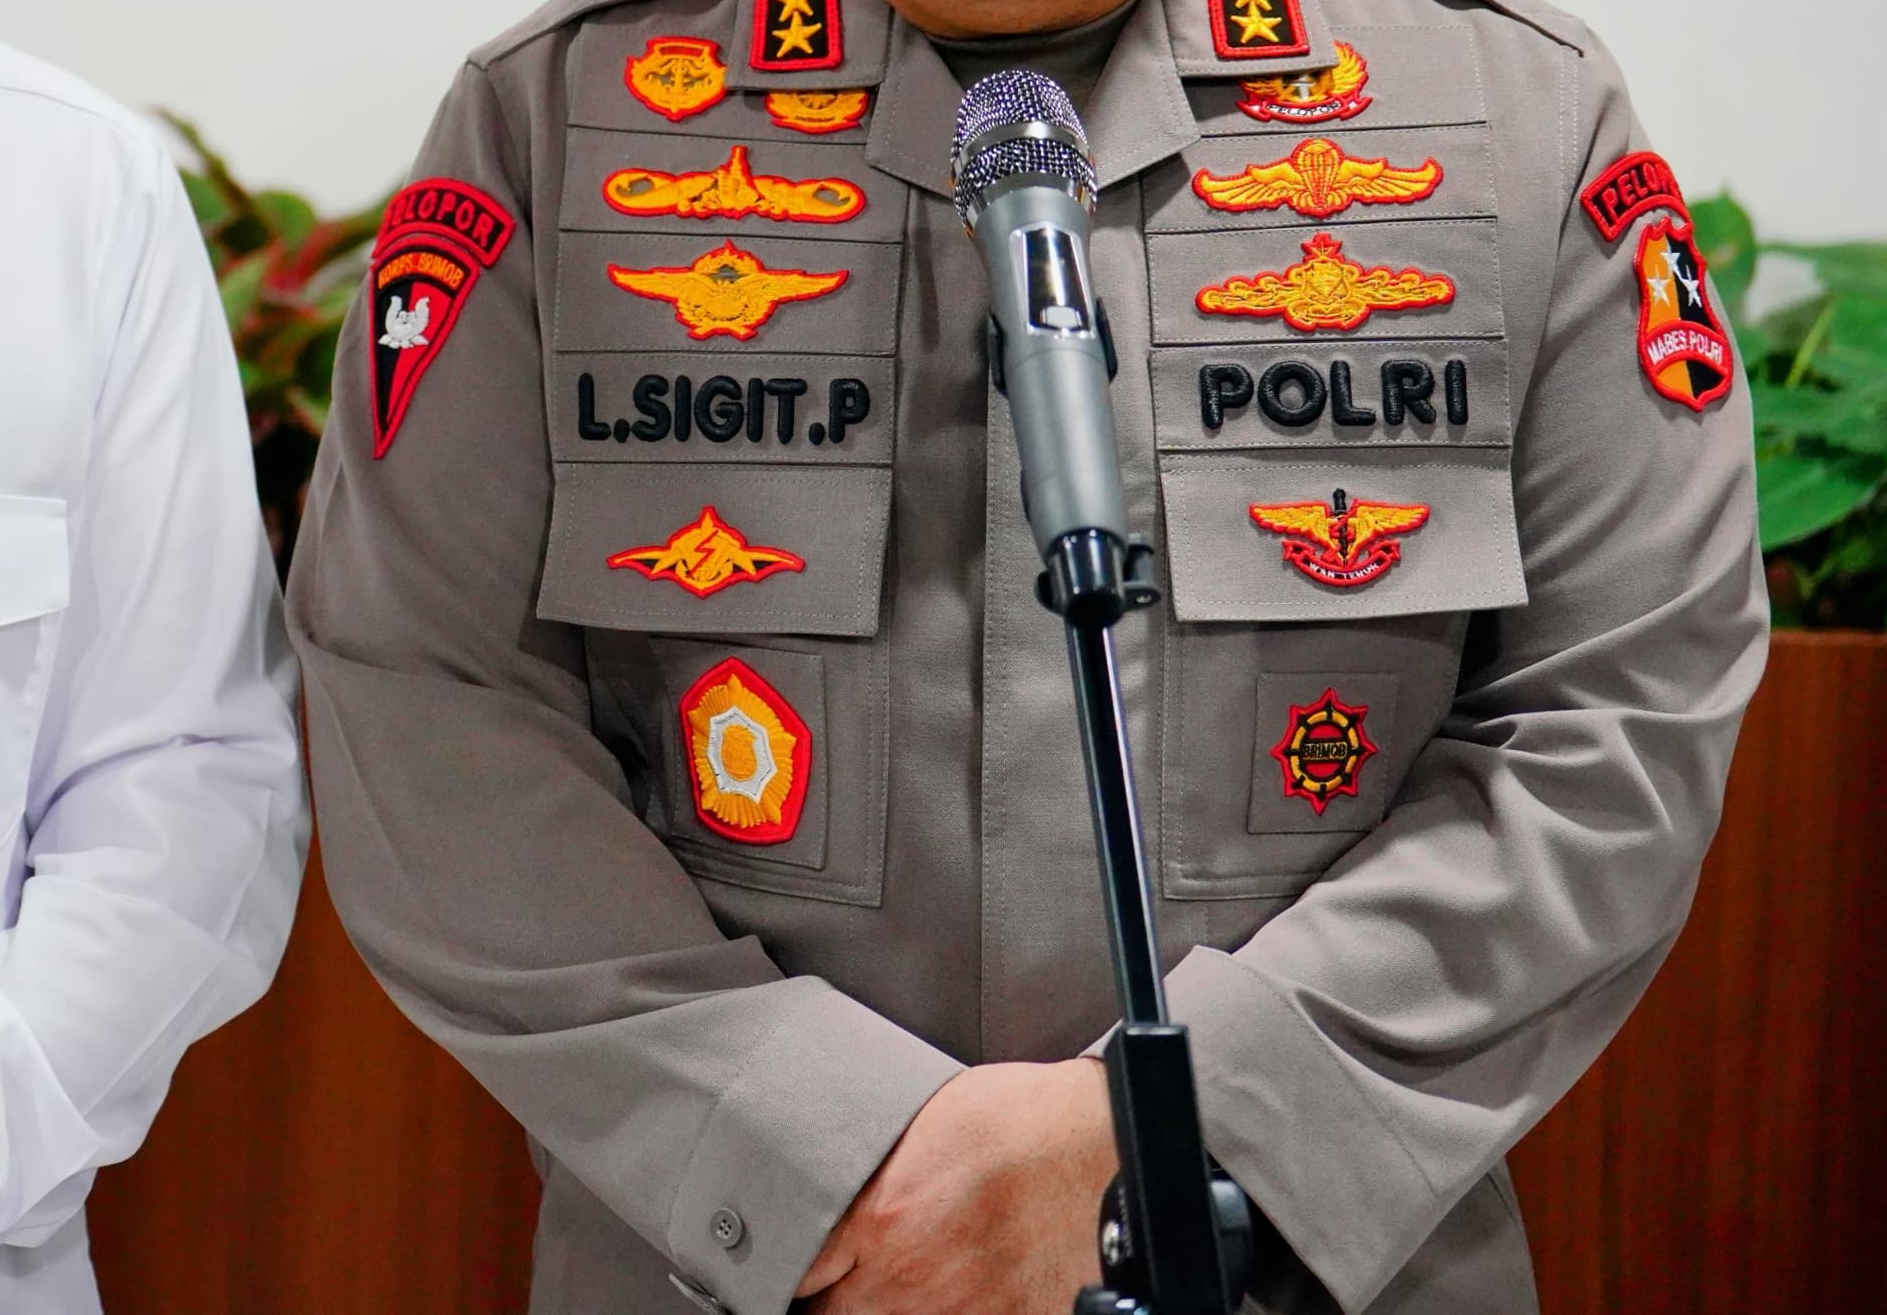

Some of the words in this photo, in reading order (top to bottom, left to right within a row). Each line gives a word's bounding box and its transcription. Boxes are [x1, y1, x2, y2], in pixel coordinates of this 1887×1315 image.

[417, 251, 465, 290] BRIMOB
[1647, 329, 1687, 365] MABES
[1688, 329, 1723, 365] POLRI
[577, 372, 871, 446] L.SIGIT.P
[1200, 359, 1468, 430] POLRI
